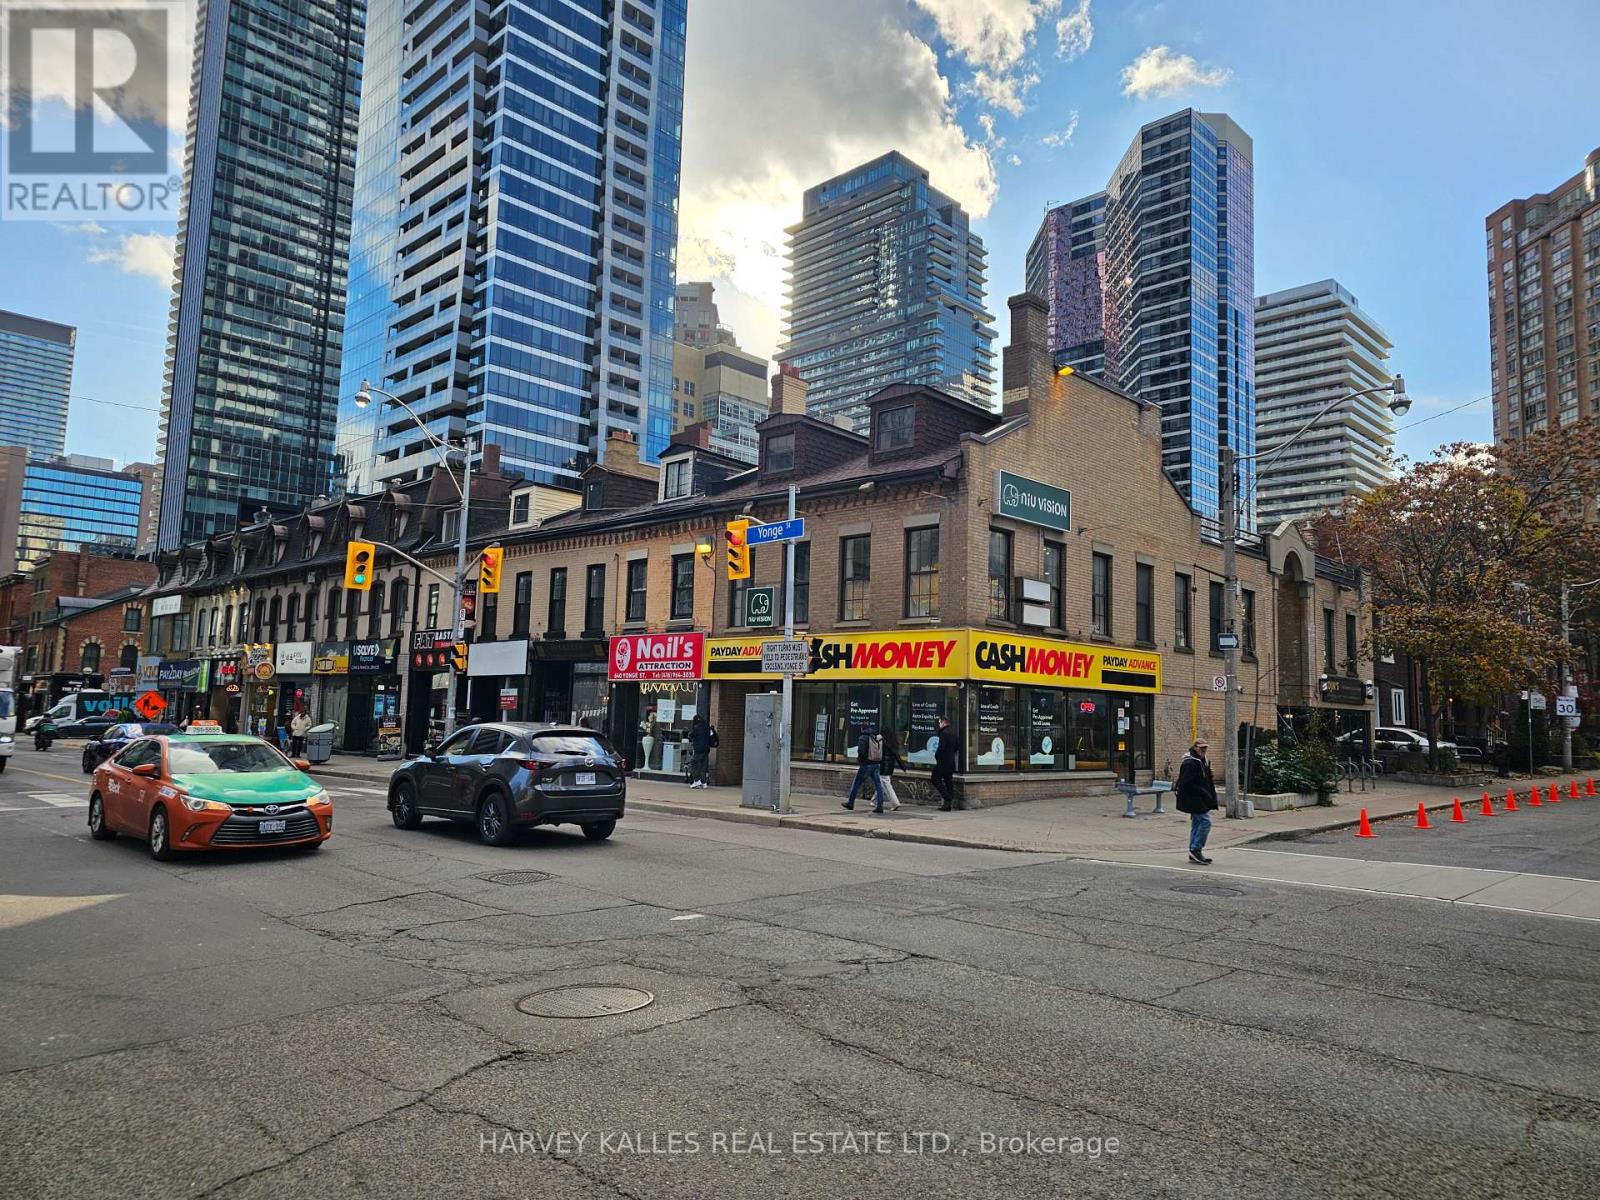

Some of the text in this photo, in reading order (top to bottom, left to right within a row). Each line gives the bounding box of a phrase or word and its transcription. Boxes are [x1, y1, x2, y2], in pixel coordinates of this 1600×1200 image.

[757, 526, 783, 539] Yonge
[414, 632, 435, 649] FAT
[434, 630, 453, 640] BAST
[352, 644, 376, 656] USOLVE
[636, 636, 694, 659] Nail's
[710, 647, 742, 657] PAYDAY
[792, 643, 803, 651] MUST
[638, 662, 692, 670] ATTRACTION
[764, 663, 784, 671] CROSSING
[784, 662, 798, 670] YONGE
[1102, 655, 1157, 671] PAYDAY ADVANCE
[1558, 704, 1574, 713] 30
